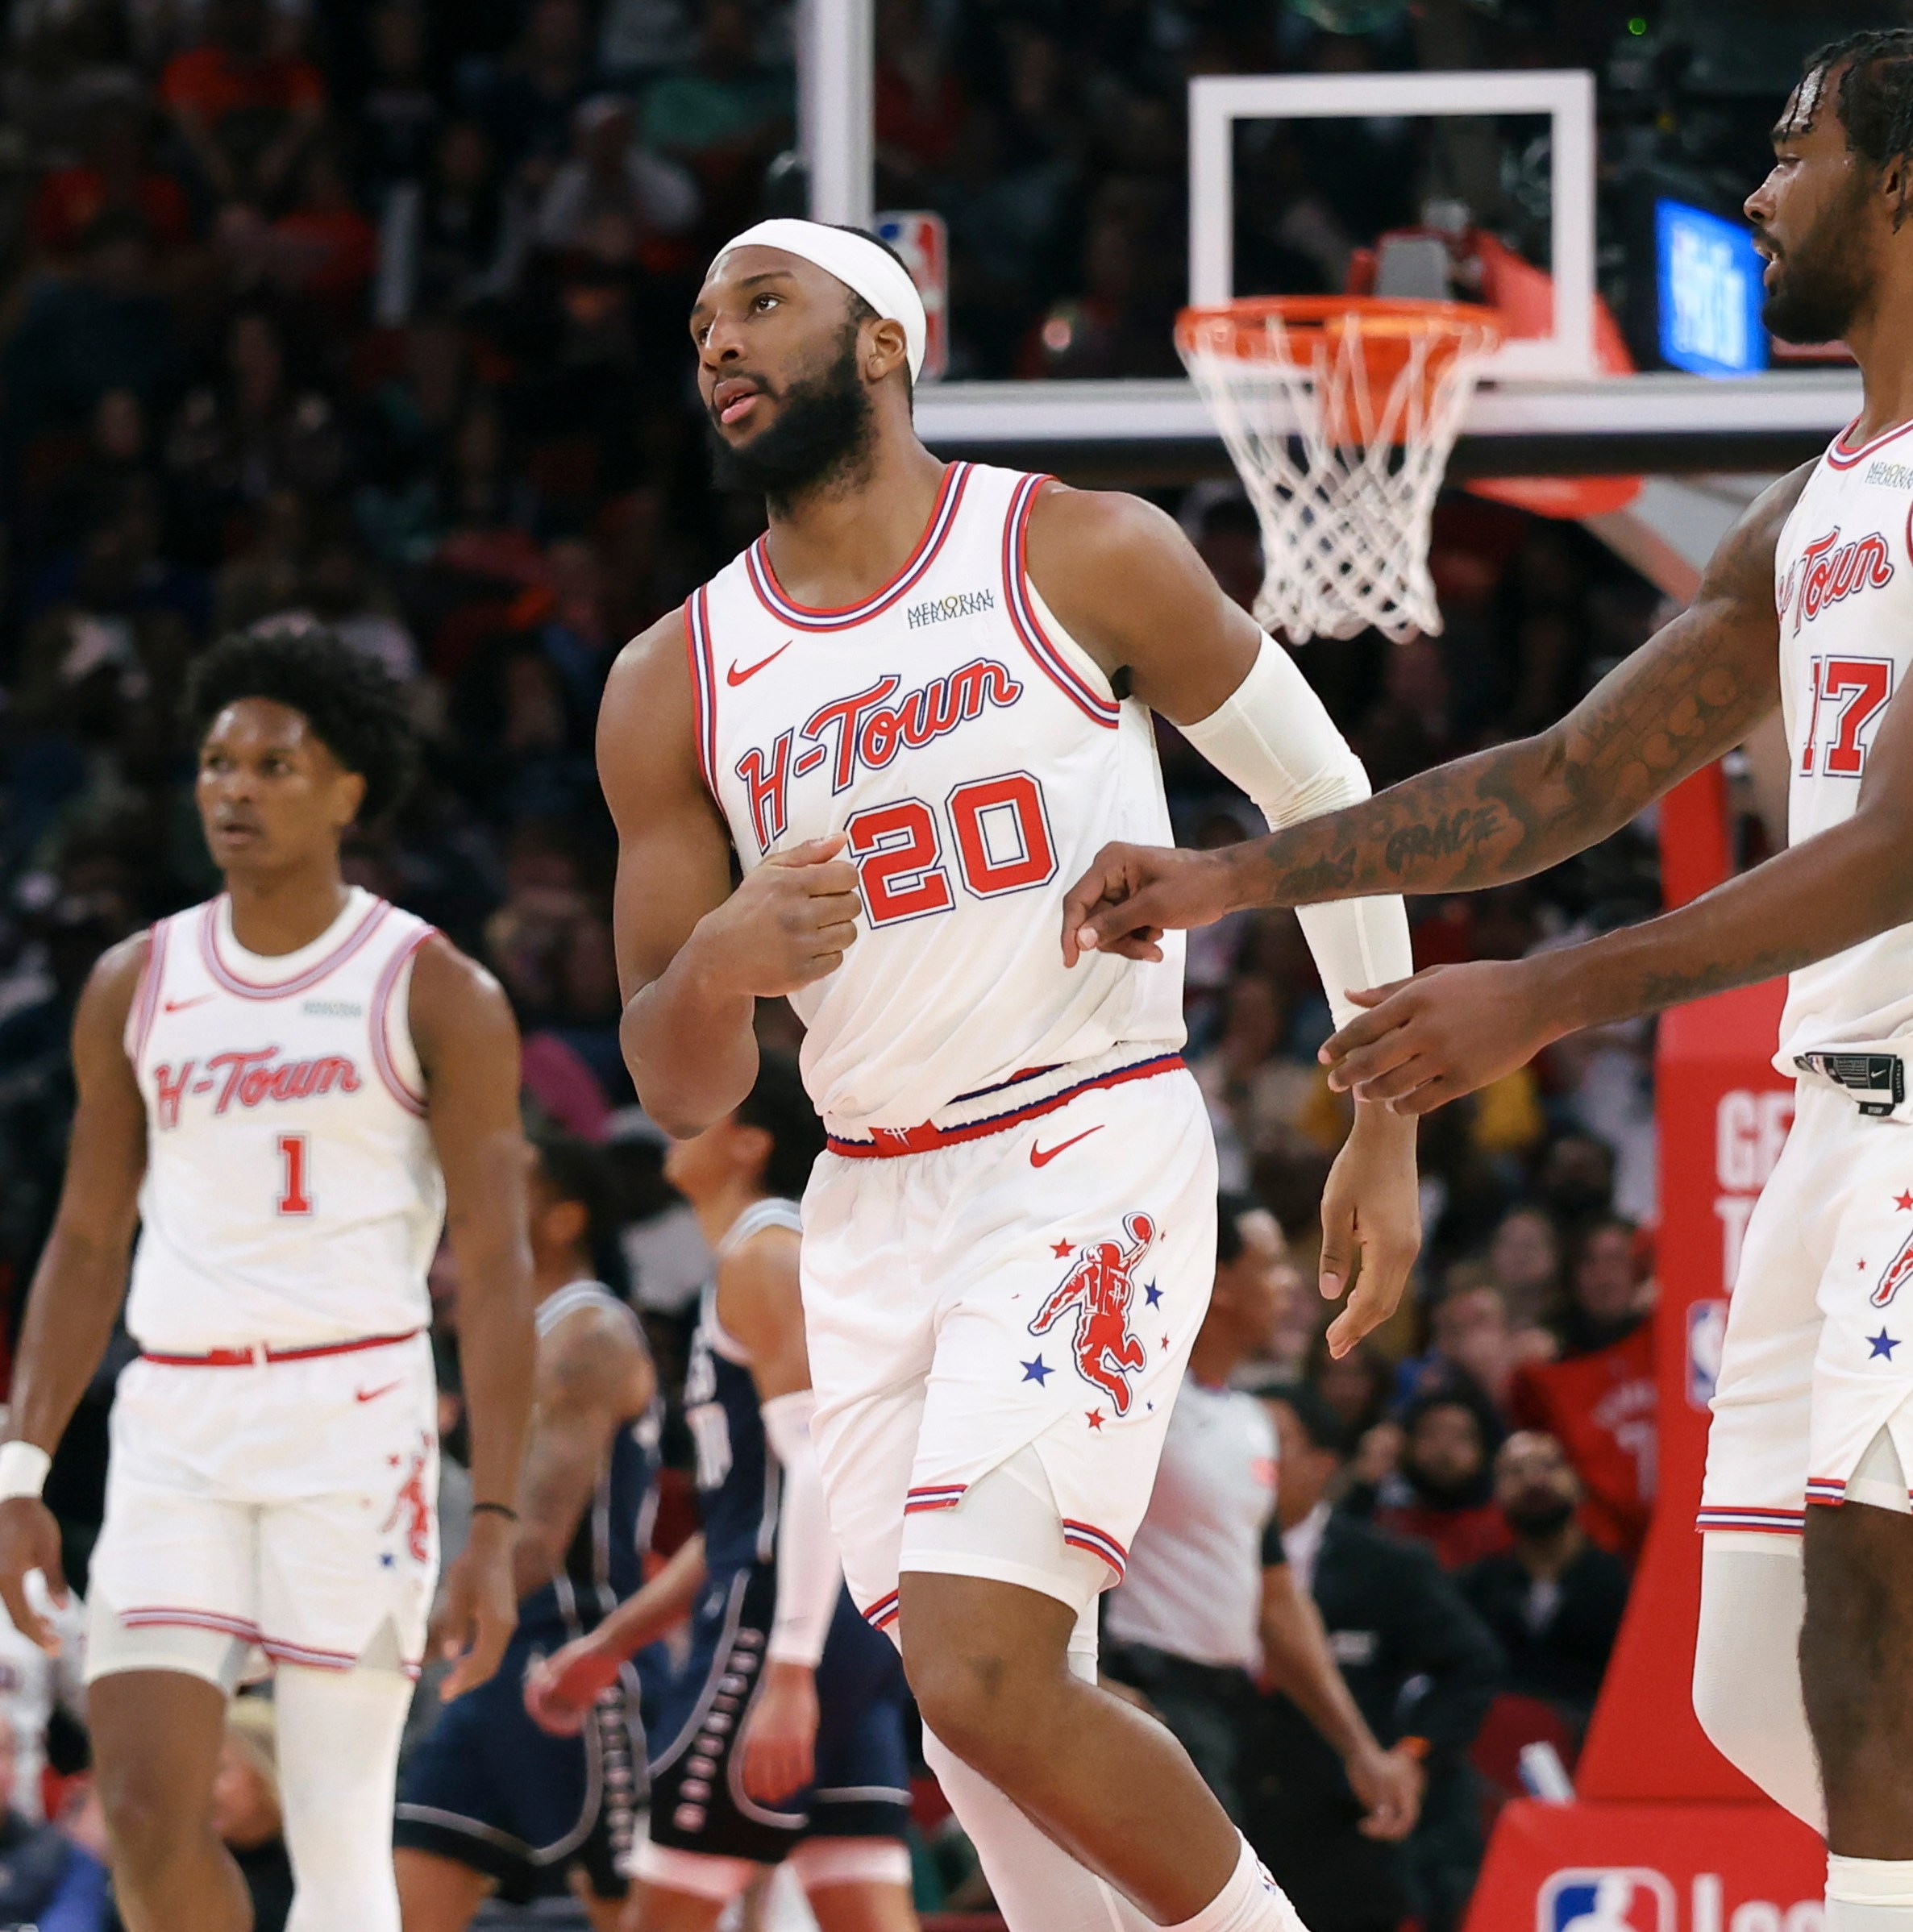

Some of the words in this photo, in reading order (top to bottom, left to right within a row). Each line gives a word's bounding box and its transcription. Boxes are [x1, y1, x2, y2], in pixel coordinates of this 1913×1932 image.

[908, 588, 994, 618] MEMORIAL
[908, 597, 994, 629] HERMANN
[1778, 526, 1894, 638] Town
[735, 657, 1023, 856] H-Town
[1799, 656, 1894, 777] 17
[844, 770, 1059, 929] 20
[154, 1045, 361, 1129] H-Town
[276, 1133, 314, 1216] 1
